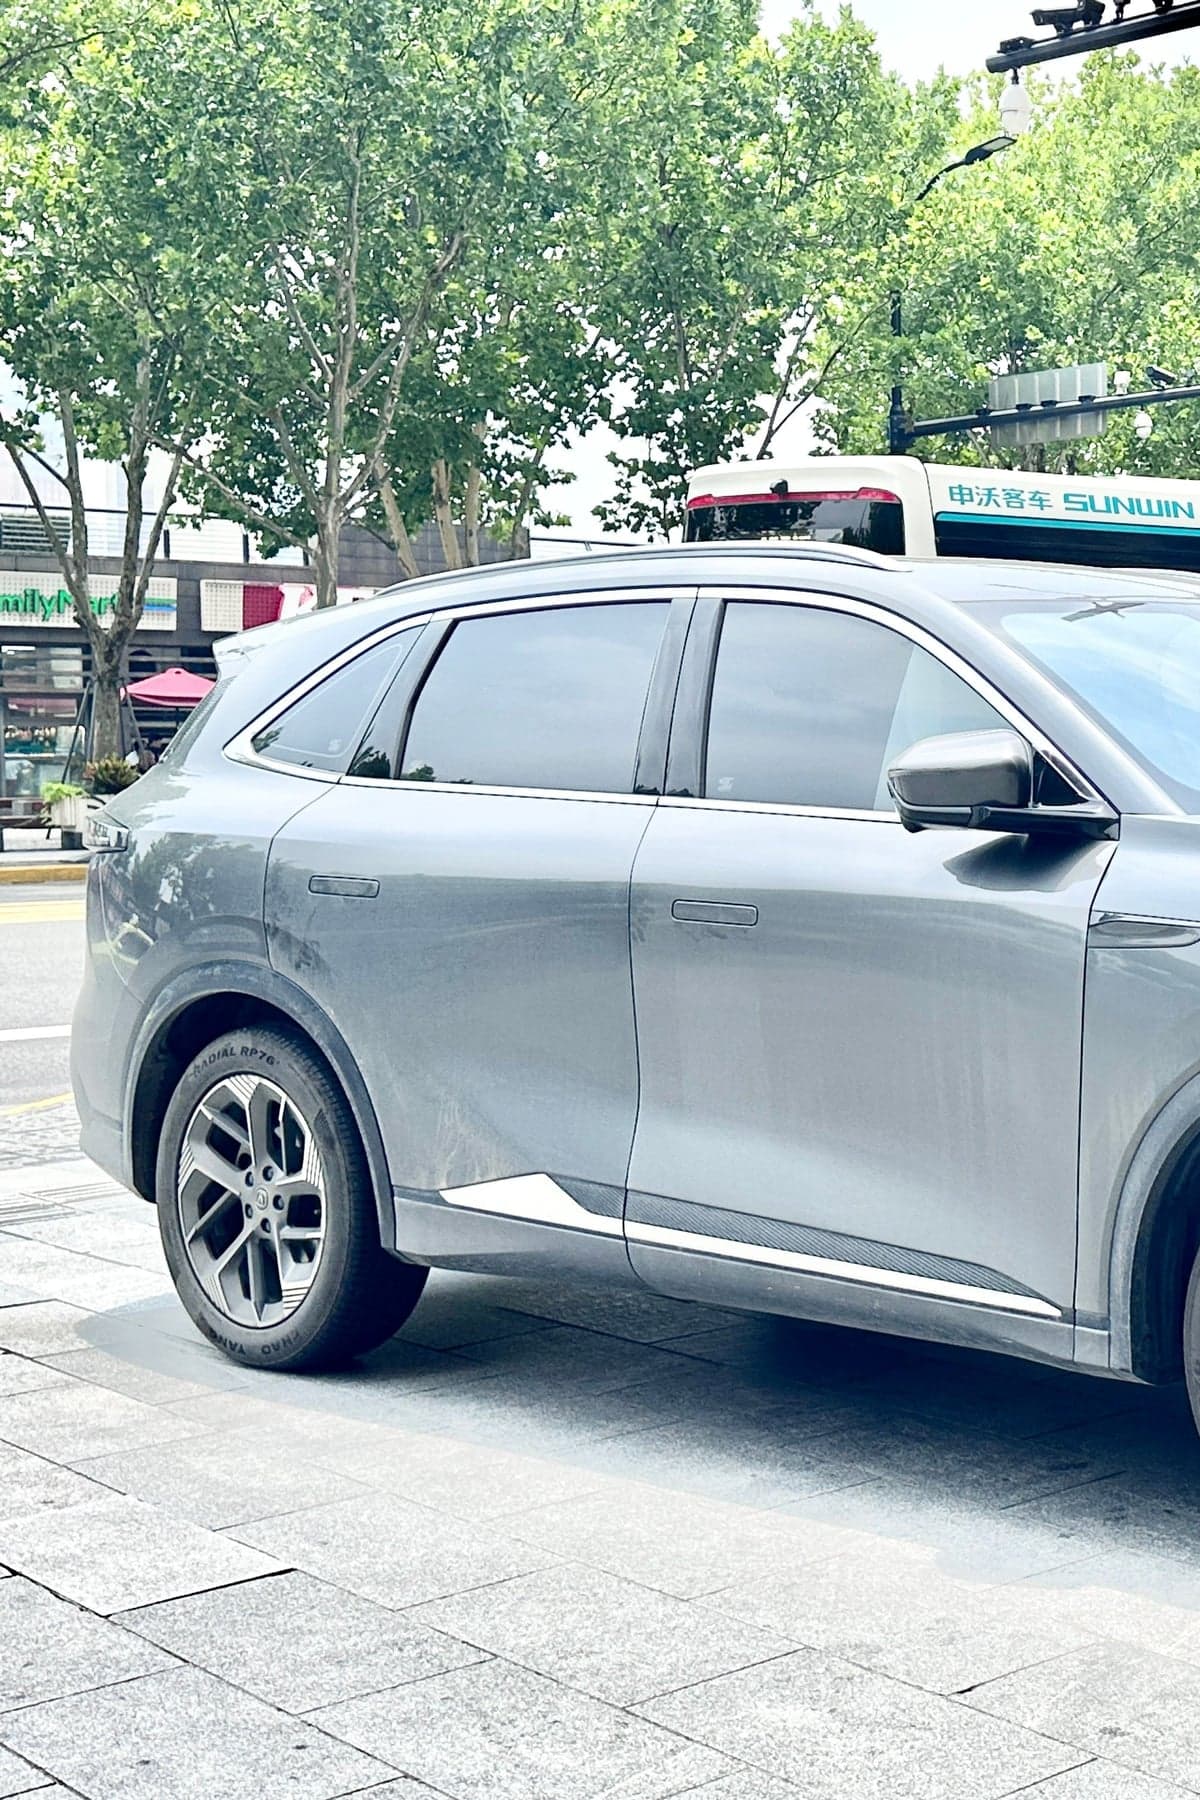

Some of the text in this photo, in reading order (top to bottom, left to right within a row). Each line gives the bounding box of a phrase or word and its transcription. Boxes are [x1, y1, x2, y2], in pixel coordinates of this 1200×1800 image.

[948, 484, 1195, 519] 申沃客车 SUNWIN
